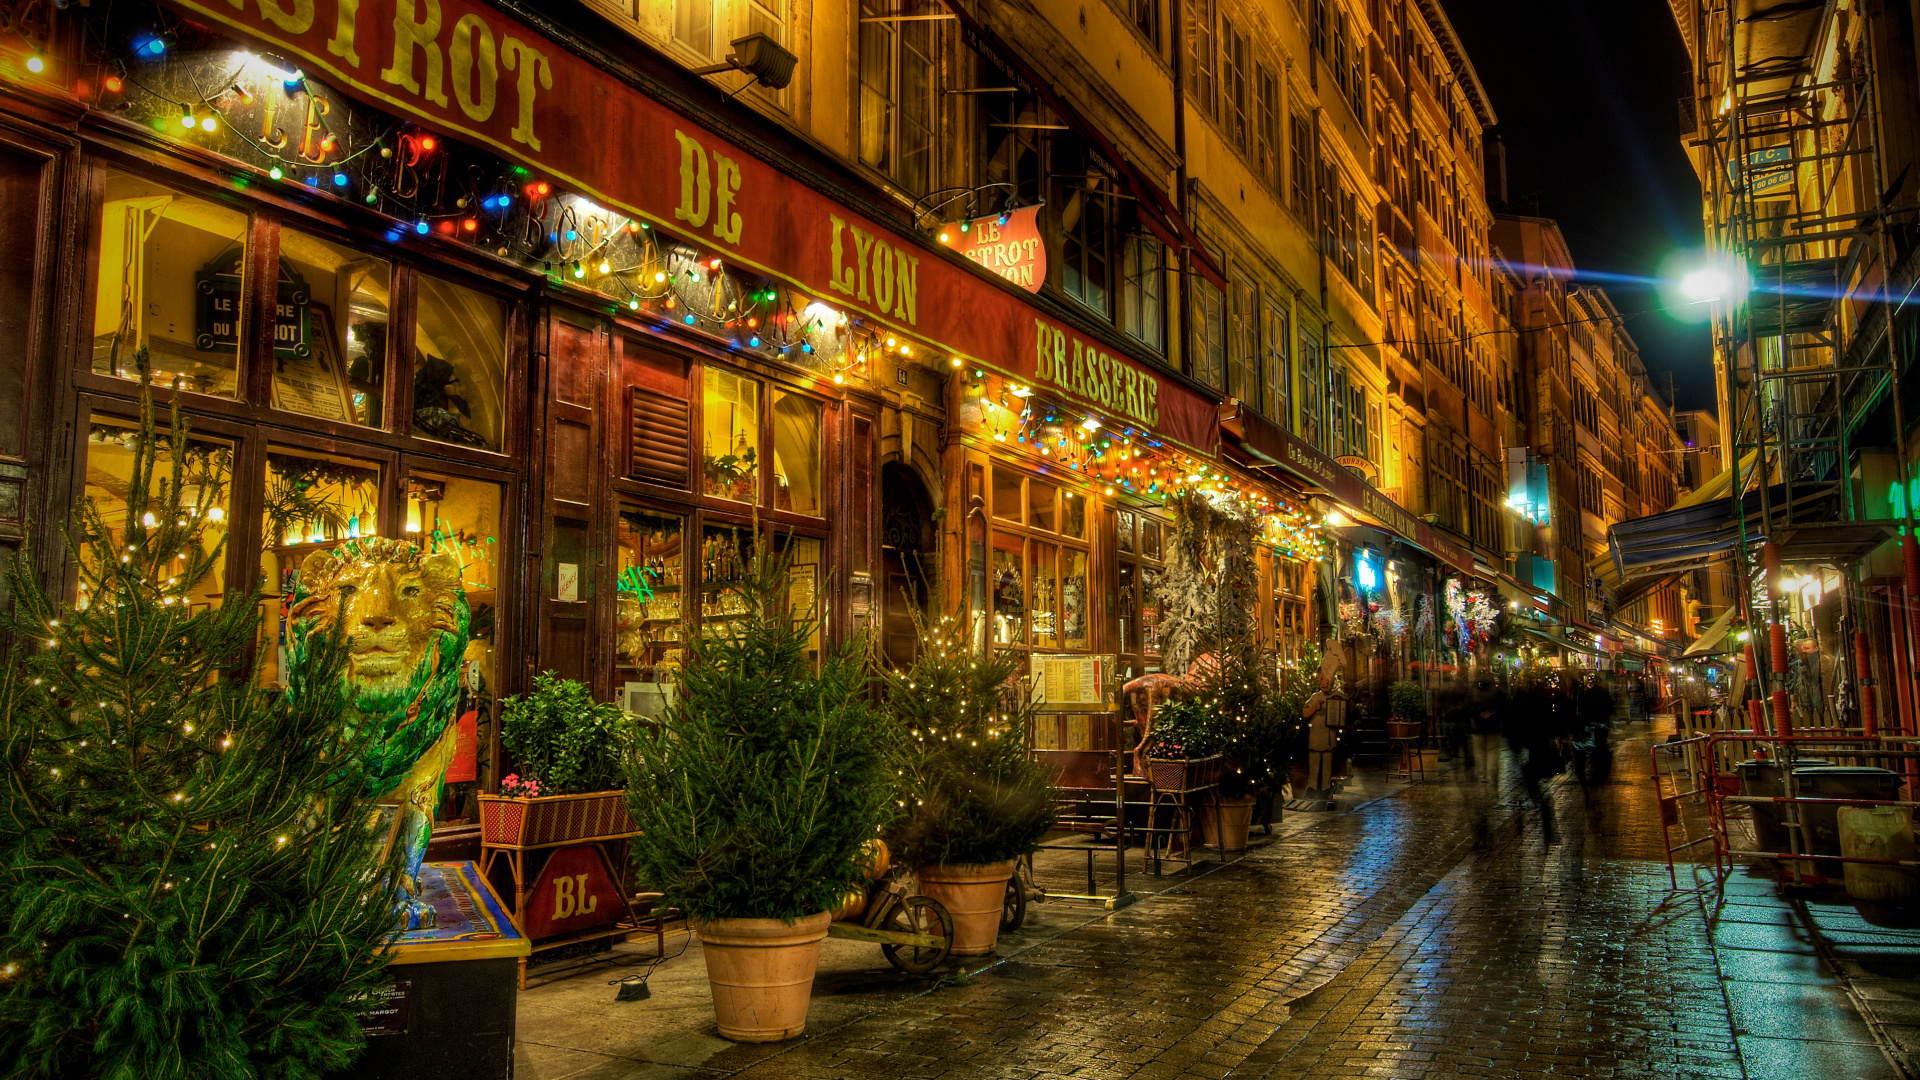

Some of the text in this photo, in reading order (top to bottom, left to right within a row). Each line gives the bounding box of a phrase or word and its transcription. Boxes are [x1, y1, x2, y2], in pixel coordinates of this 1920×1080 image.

[976, 220, 1001, 245] LE
[675, 129, 743, 246] DE
[829, 212, 920, 326] LYON
[1035, 318, 1159, 427] BRASSERIE
[214, 298, 232, 311] LE
[213, 322, 230, 336] DU
[551, 873, 598, 920] BL
